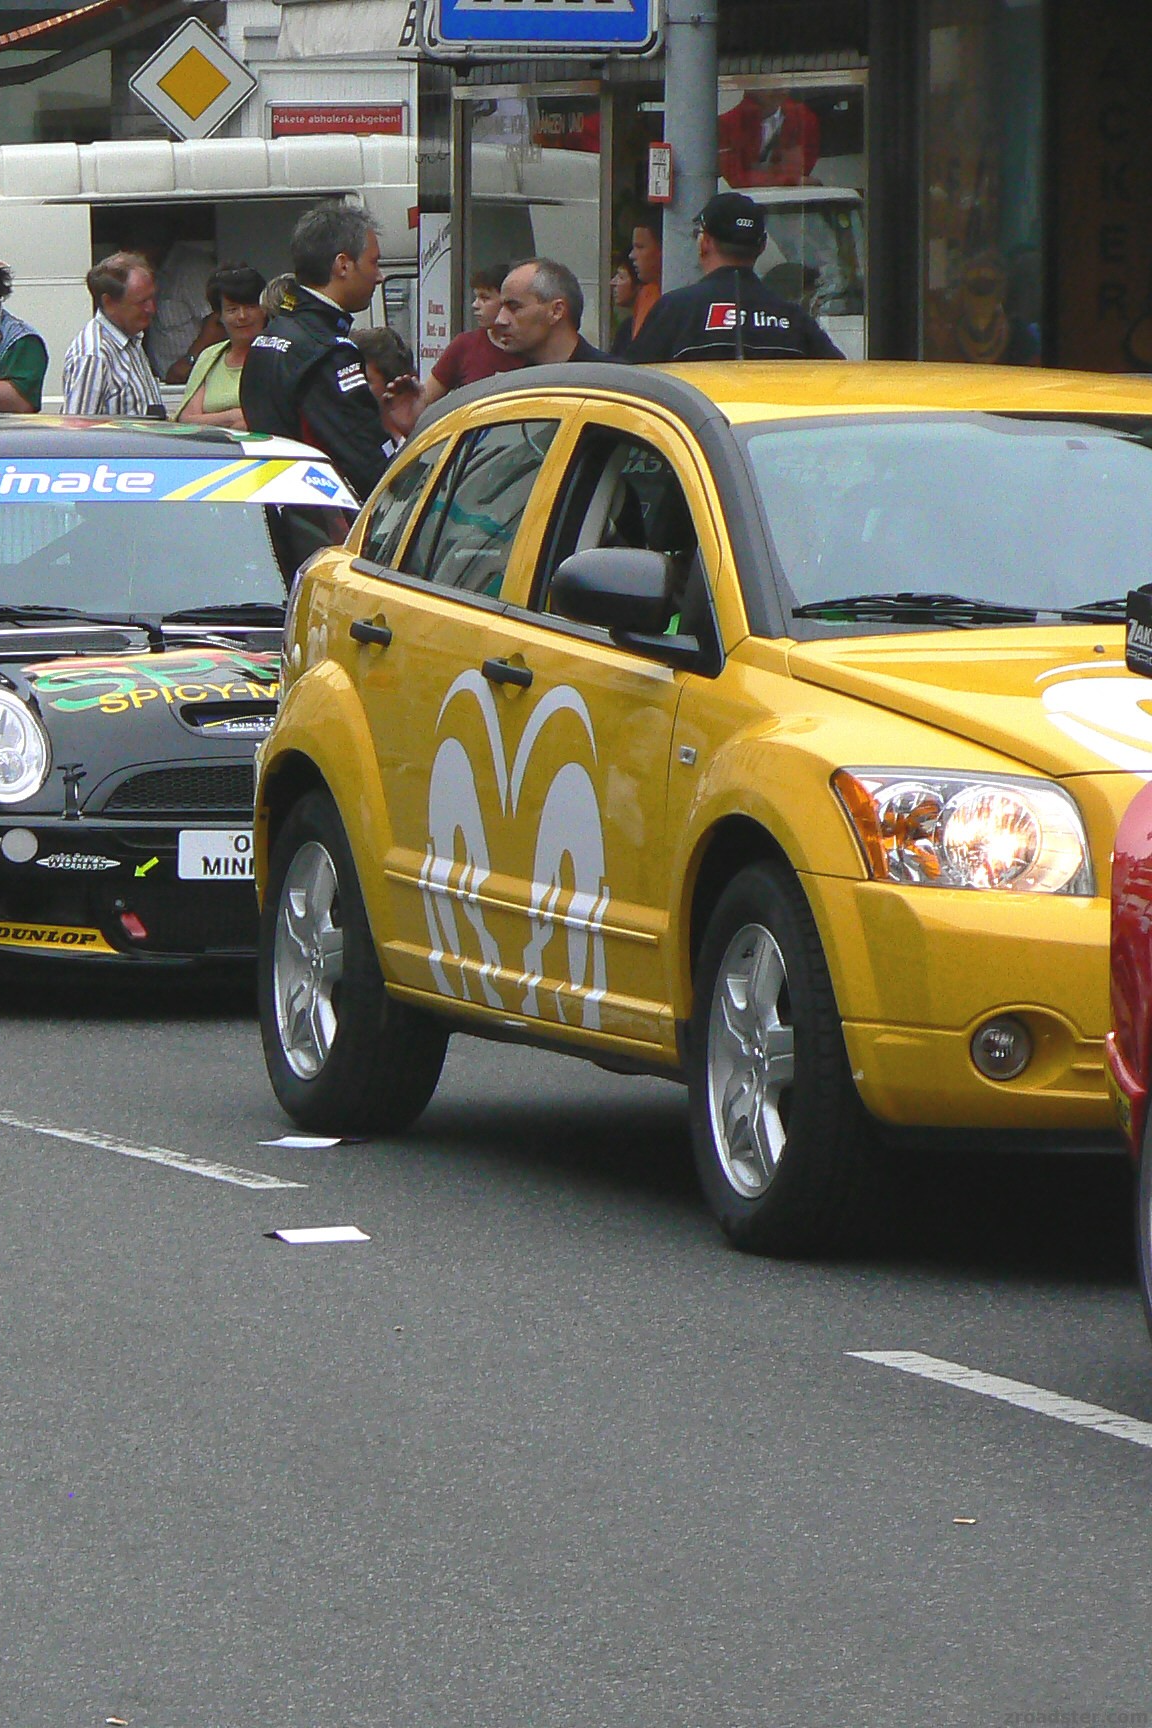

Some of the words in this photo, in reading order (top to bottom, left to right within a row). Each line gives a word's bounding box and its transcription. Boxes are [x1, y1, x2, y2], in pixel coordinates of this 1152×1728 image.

[273, 114, 305, 124] Pakete
[753, 310, 790, 329] line
[305, 474, 338, 490] ARAL
